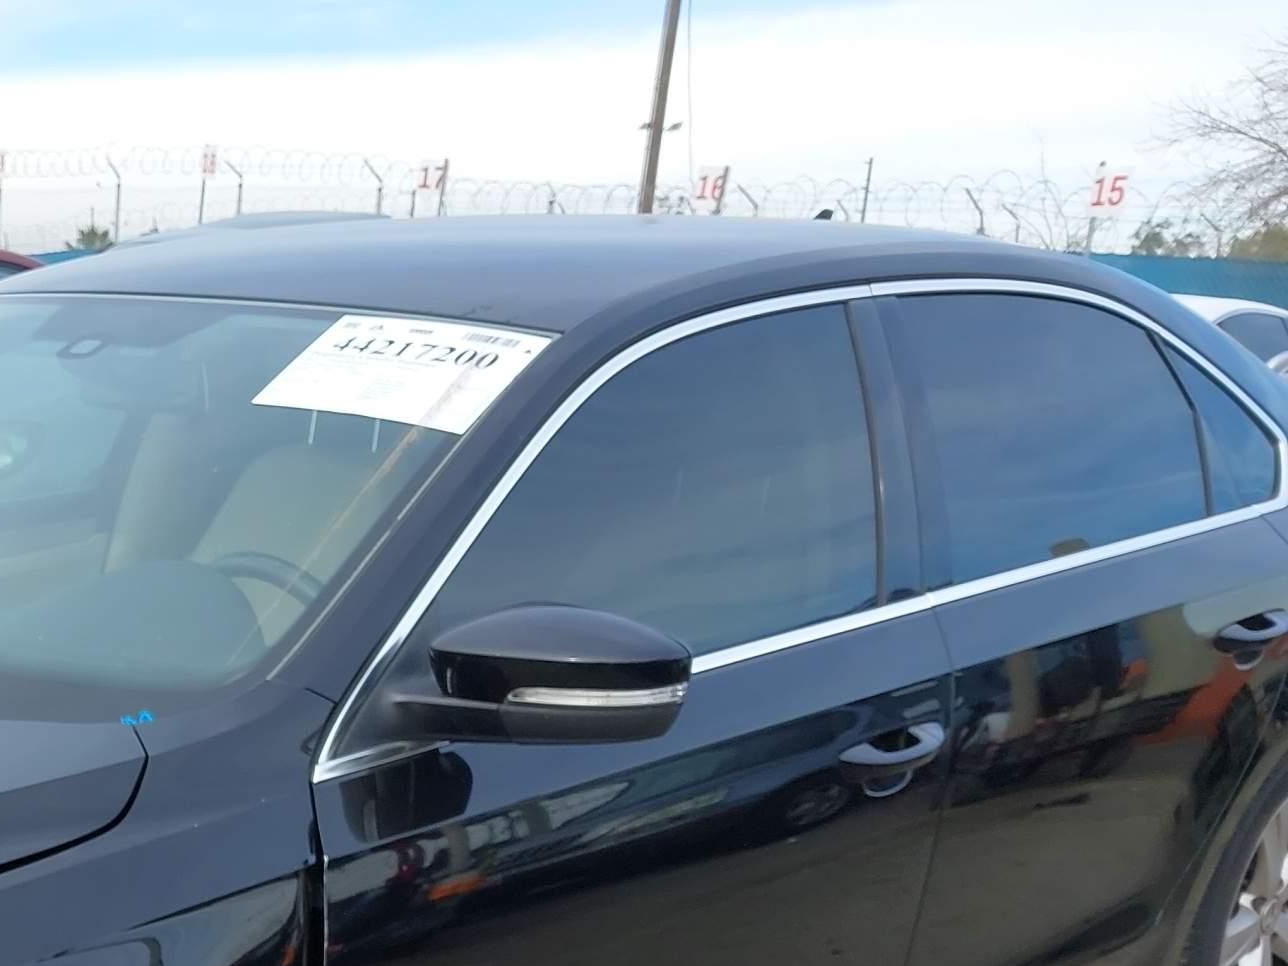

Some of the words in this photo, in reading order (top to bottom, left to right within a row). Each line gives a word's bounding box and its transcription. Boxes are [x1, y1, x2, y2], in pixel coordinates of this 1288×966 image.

[418, 167, 447, 189] 17
[696, 175, 724, 201] 16
[1091, 176, 1128, 206] 15
[333, 335, 500, 369] 44217200
